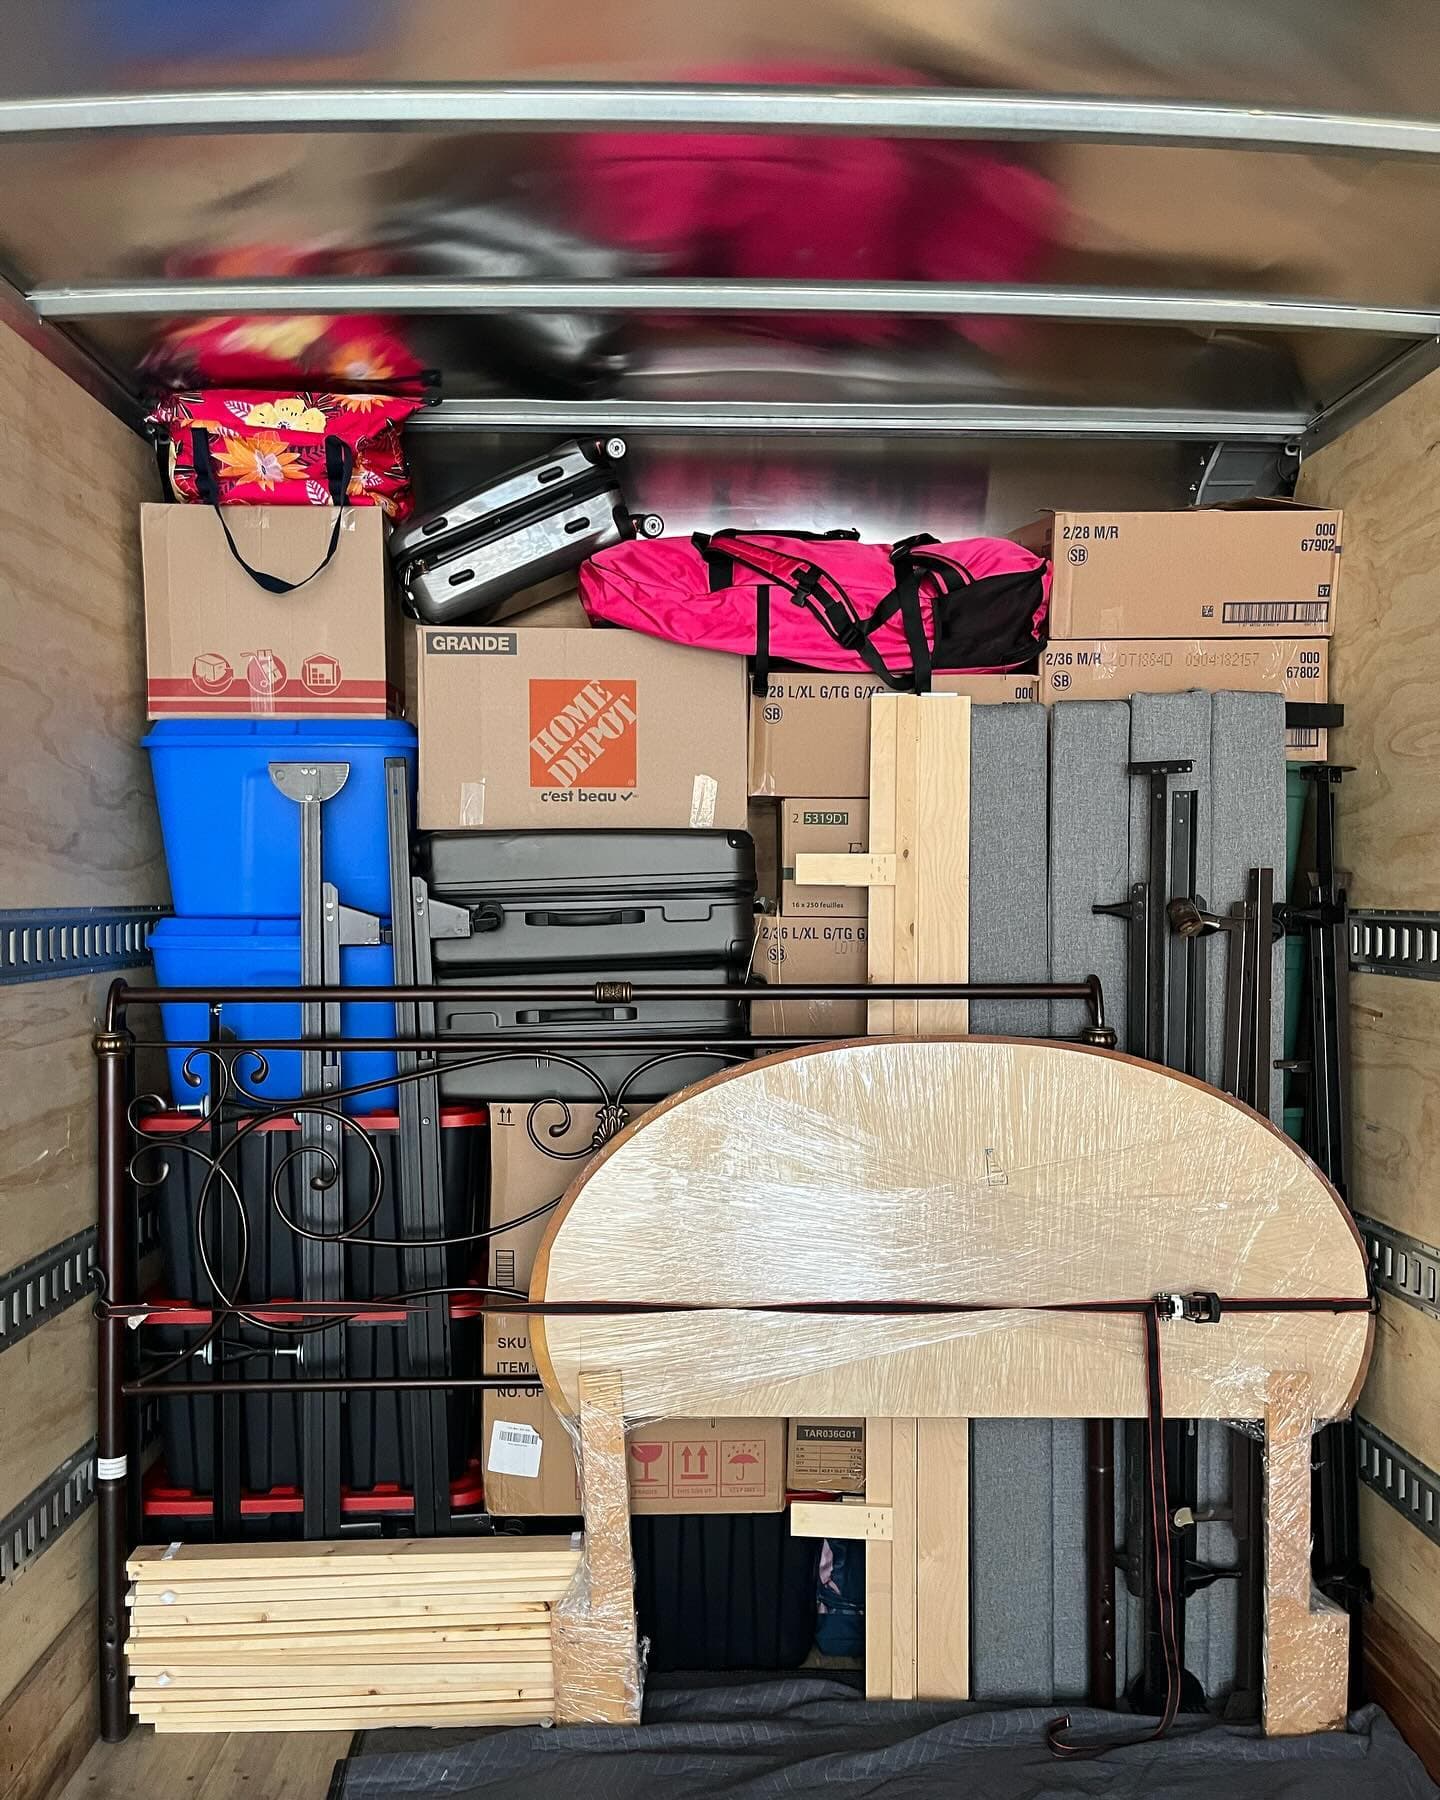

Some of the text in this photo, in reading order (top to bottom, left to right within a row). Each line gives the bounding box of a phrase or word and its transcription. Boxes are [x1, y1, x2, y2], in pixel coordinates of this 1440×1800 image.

[1063, 526, 1119, 540] 2/28 M/R
[1315, 523, 1336, 536] 000
[1301, 539, 1335, 551] 67902
[1070, 549, 1085, 562] SB
[1319, 586, 1330, 596] 57
[432, 635, 510, 651] GRANDE
[1046, 653, 1073, 666] 2/36
[1300, 652, 1320, 664] 000
[1286, 666, 1320, 679] 67802
[1053, 675, 1069, 687] SB
[788, 685, 815, 699] L/XL
[820, 685, 850, 699] G/TG
[1015, 687, 1034, 699] 000
[765, 707, 781, 720] SB
[530, 680, 613, 764] HOME
[547, 694, 638, 788] DEPOT
[540, 788, 617, 802] c'est beau
[792, 813, 848, 824] 2 5319D1
[762, 927, 788, 940] 2/36
[792, 927, 819, 940] L/XL
[823, 927, 852, 941] G/TG
[497, 1336, 527, 1349] SKU
[497, 1387, 521, 1398] NO.
[804, 1428, 857, 1439] TAR036G01
